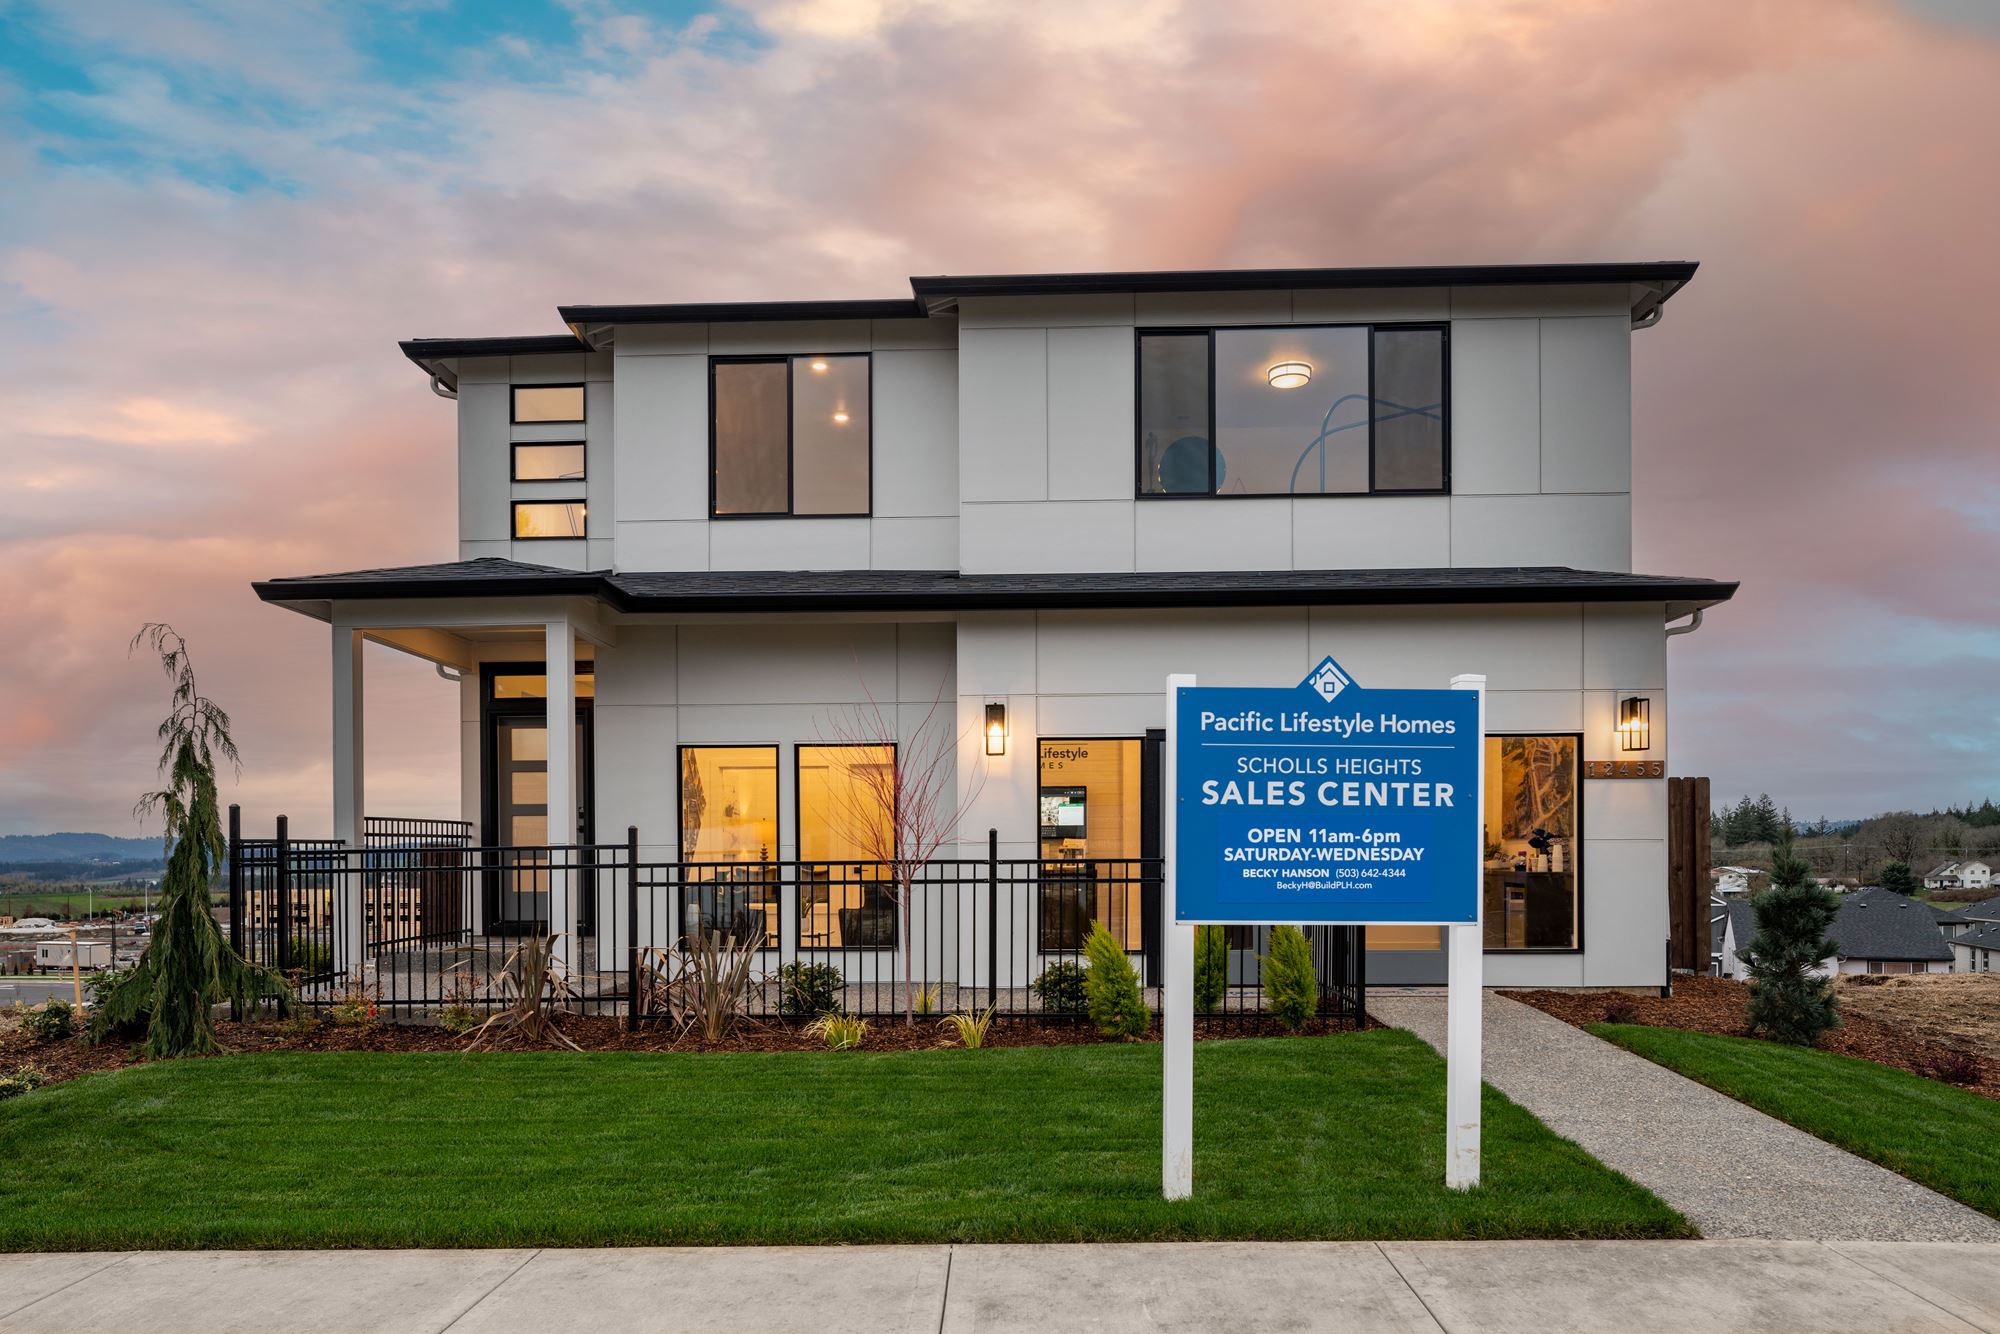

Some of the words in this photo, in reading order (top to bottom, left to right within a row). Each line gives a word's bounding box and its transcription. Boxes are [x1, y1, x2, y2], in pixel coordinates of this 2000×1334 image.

[1201, 711, 1274, 732] Pacific
[1280, 712, 1375, 739] Lifestyle
[1380, 714, 1456, 734] Homes
[1237, 757, 1328, 774] SCHOLLS
[1335, 758, 1422, 775] HEIGHTS
[1202, 780, 1305, 806] SALES
[1317, 781, 1455, 807] CENTER
[1247, 828, 1301, 843] OPEN
[1308, 828, 1401, 847] 11am-6pm
[1223, 847, 1425, 862] SATURDAY-WEDNESDAY
[1242, 868, 1279, 878] BECKY
[1281, 869, 1330, 878] HANSON
[1335, 868, 1359, 879] (503)
[1360, 868, 1406, 878] 642-4344
[1276, 881, 1373, 891] BeckyH@BuildPLH.com
